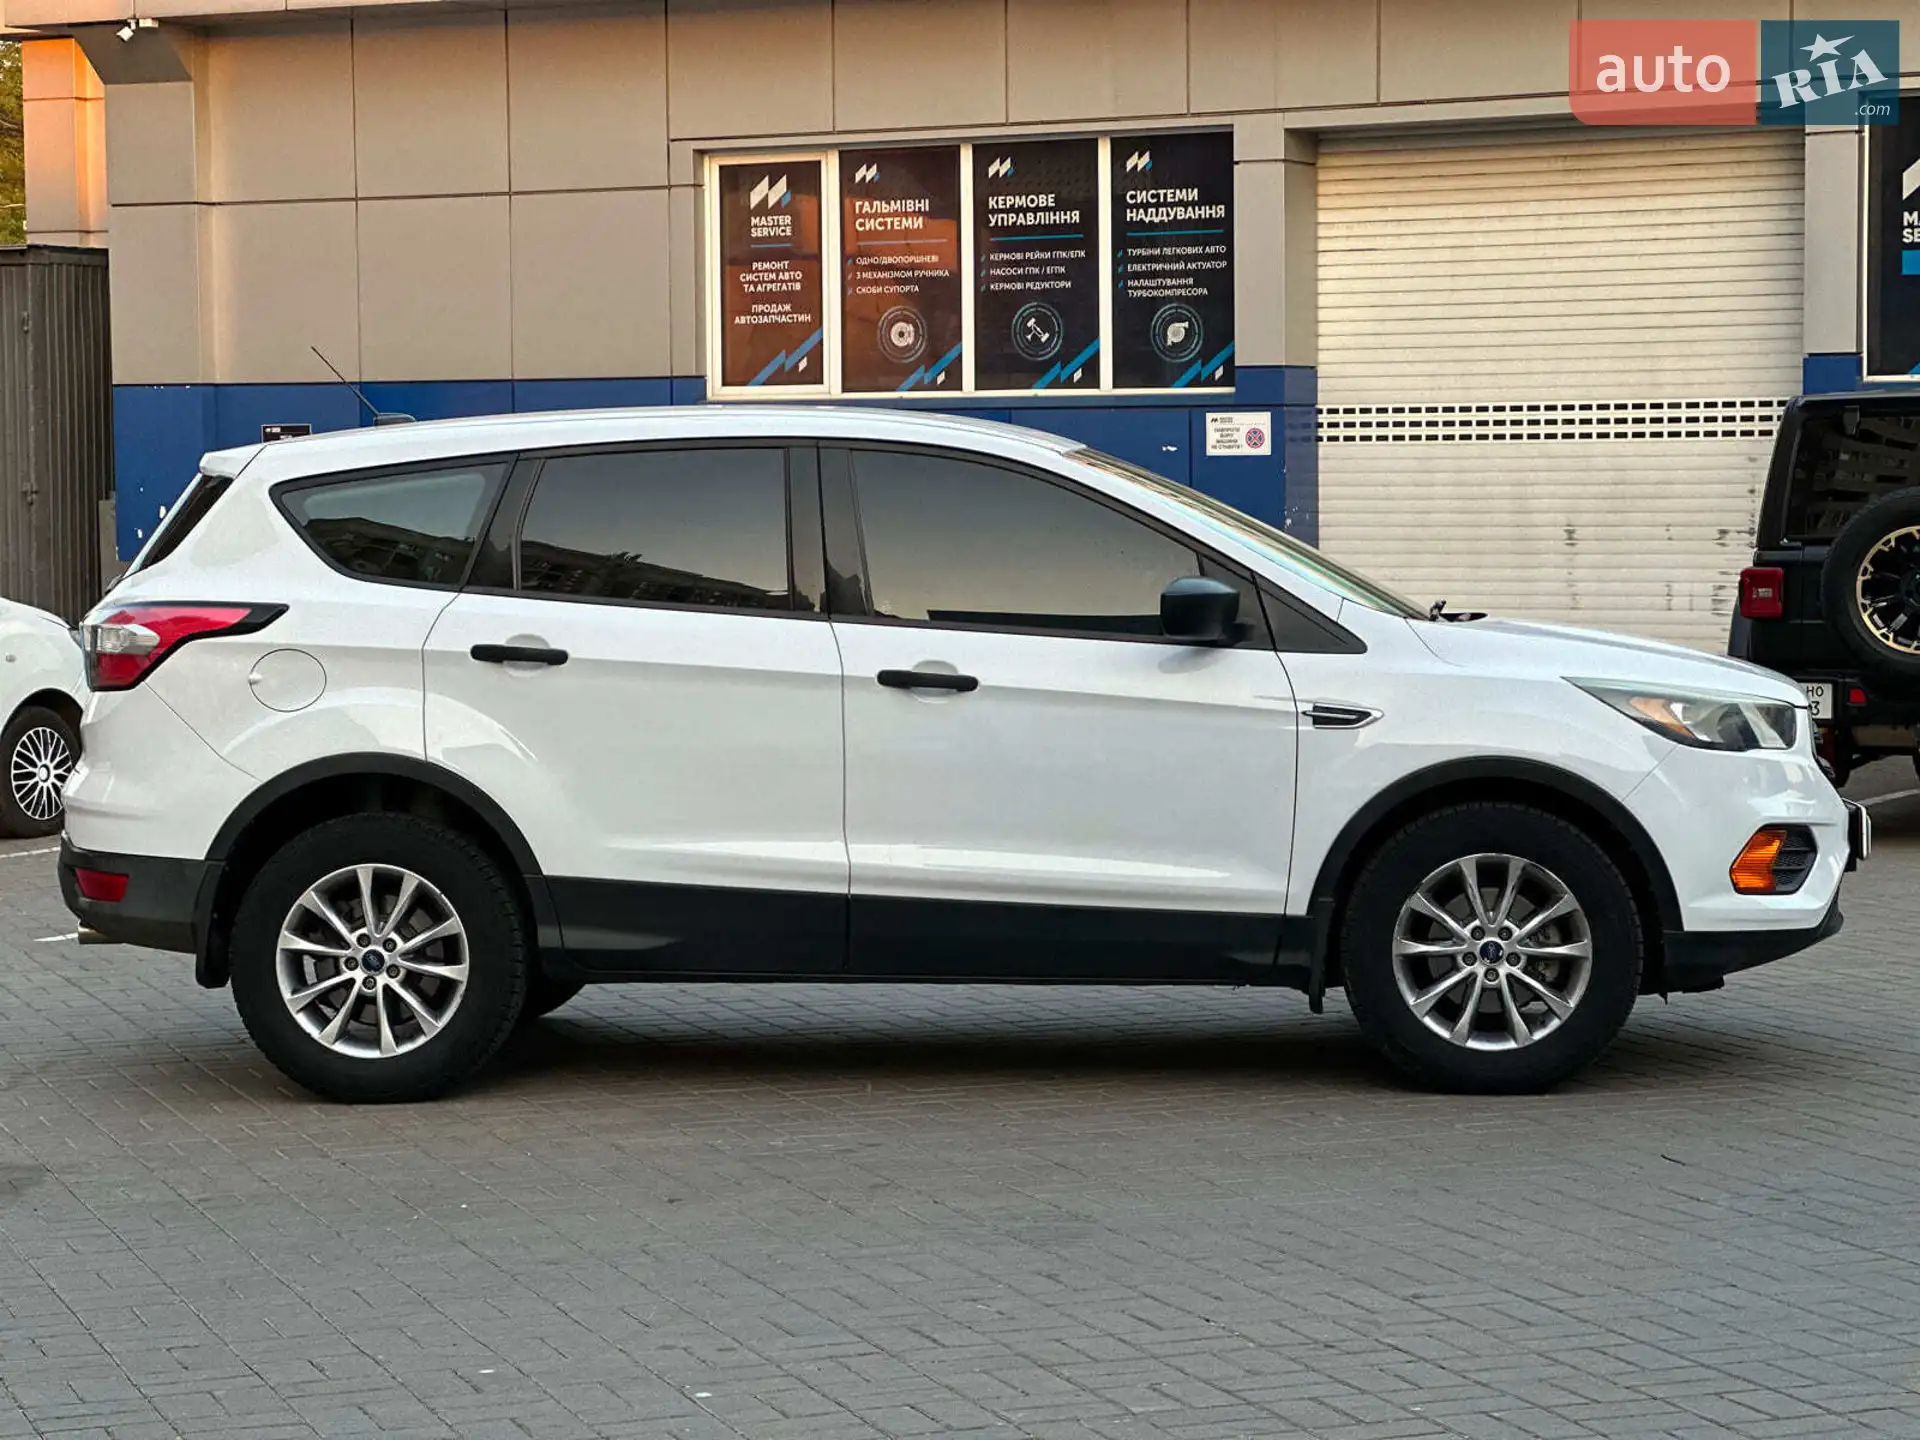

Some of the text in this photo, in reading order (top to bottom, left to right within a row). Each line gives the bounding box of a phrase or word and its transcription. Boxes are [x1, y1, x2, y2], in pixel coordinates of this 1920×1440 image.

[988, 193, 1056, 210] КЕРМОВЕ
[1126, 188, 1198, 204] СИСТЕМИ
[855, 198, 929, 215] ГАЛЬМІВНІ
[988, 210, 1080, 227] УПРАВЛІННЯ
[1126, 205, 1225, 223] НАДДУВАННЯ
[750, 215, 791, 227] MASTER
[855, 216, 924, 231] СИСТЕМИ
[750, 226, 792, 237] SERVICE
[990, 252, 1024, 261] КЕРМОВІ
[1025, 250, 1051, 260] РЕЙКИ
[1127, 245, 1227, 256] ТУРБІНИ ЛЕГКОВИХ АВТО
[752, 260, 789, 271] РЕМОНТ
[990, 266, 1023, 276] НАСОСИ
[1025, 266, 1040, 275] ГПК
[1127, 260, 1228, 272] ЕЛЕКТРИЧНИЙ АКТУАТОР
[739, 270, 802, 282] СИСТЕМ АВТО
[862, 269, 913, 279] МЕХАНІЗМОМ
[914, 268, 950, 278] РУЧНИКА
[743, 282, 801, 293] ТА АГРЕГАТІВ
[990, 280, 1072, 290] КЕРМОВІ РЕДУКТОРИ
[1127, 277, 1194, 287] НАЛАШТУВАННЯ
[856, 284, 920, 295] СКОБИ СУПОРТА
[1127, 287, 1208, 298] ТУРБОКОМПРЕСОРА
[751, 303, 792, 314] ПРОДАЖ
[734, 313, 811, 325] АВТОЗАПЧАСТИН
